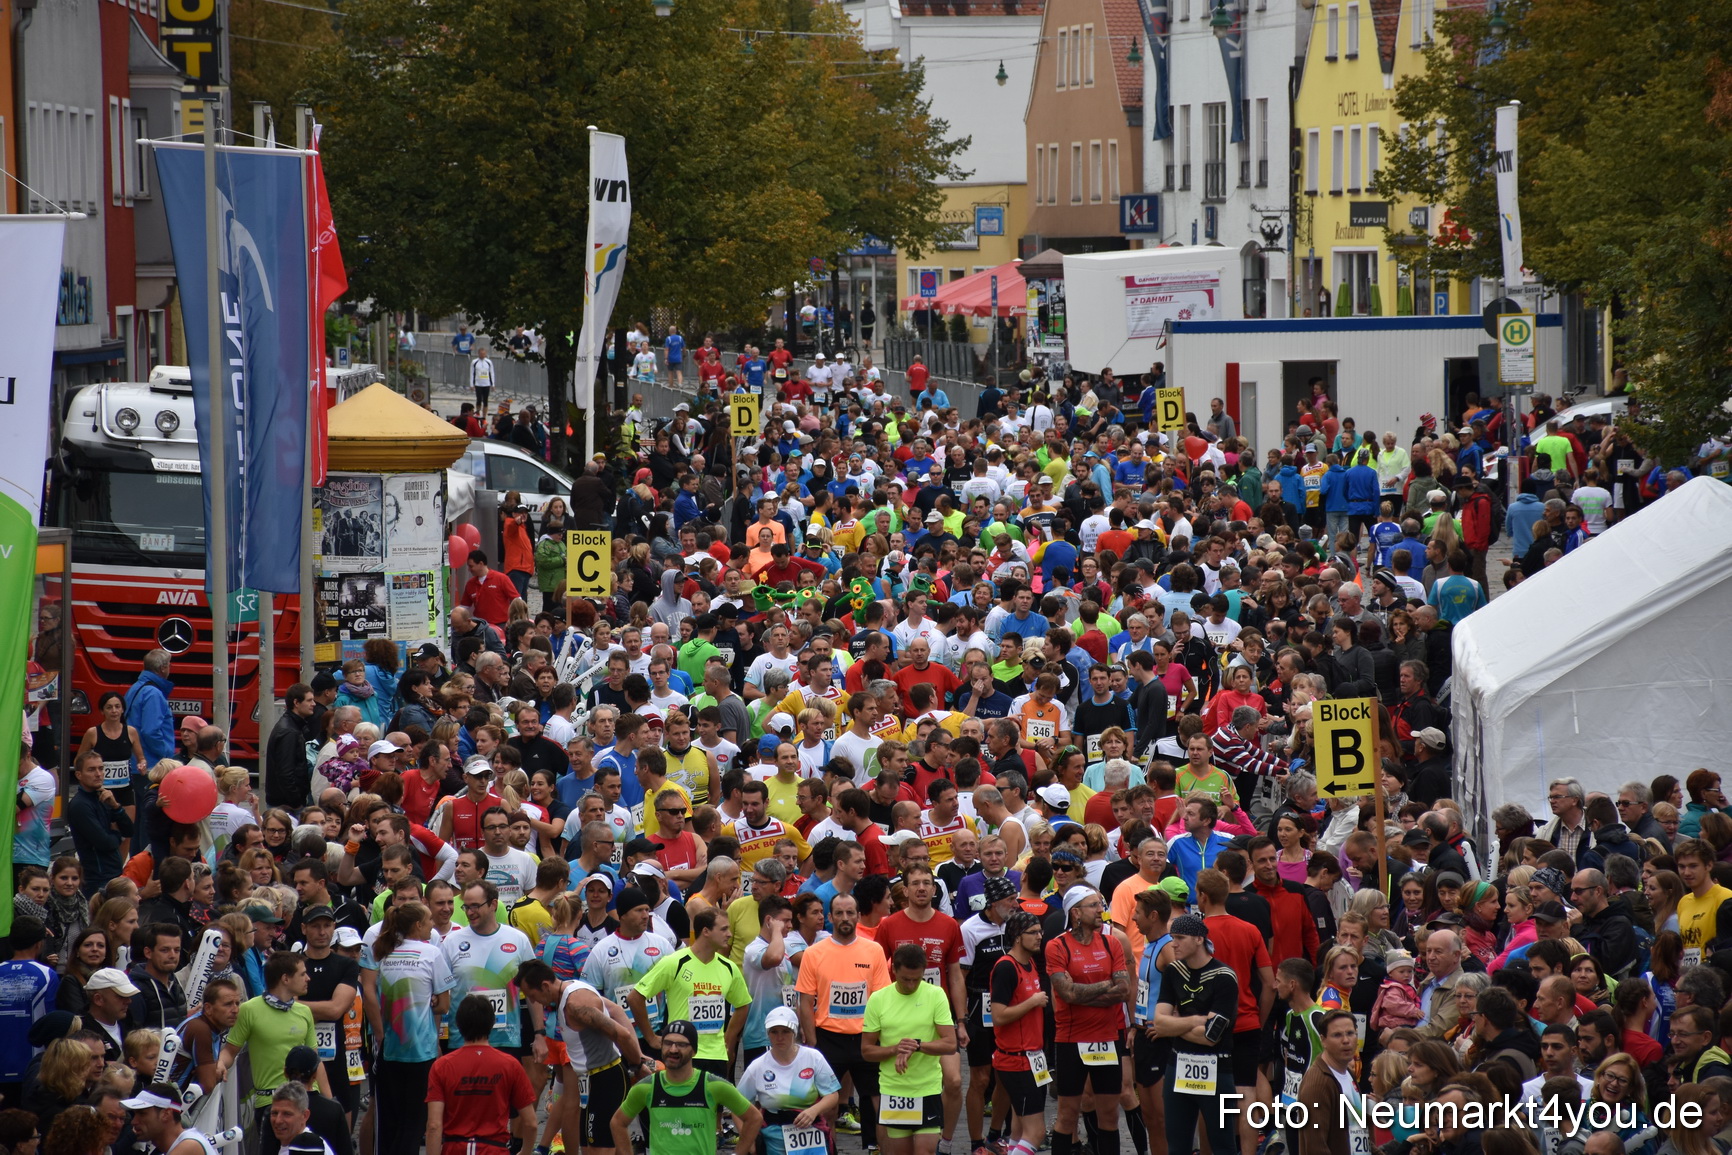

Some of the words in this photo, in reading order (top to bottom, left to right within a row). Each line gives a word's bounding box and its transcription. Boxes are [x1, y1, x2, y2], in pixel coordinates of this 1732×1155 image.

[1338, 92, 1360, 117] HOTEL
[1140, 295, 1174, 304] DAHMIT
[1509, 324, 1524, 340] H
[733, 395, 756, 404] Block
[1159, 389, 1182, 398] Block
[737, 406, 752, 427] D
[1164, 400, 1179, 422] D
[156, 474, 203, 487] böhseonk
[142, 538, 172, 547] BANFF
[572, 533, 606, 546] Block
[577, 550, 600, 582] C
[324, 581, 339, 591] MARK
[156, 589, 198, 606] AVIA
[320, 591, 339, 601] BENDER
[325, 606, 339, 616] BAND
[340, 608, 368, 617] CASH
[182, 702, 200, 712] 116
[1320, 703, 1371, 722] Block
[1032, 726, 1050, 738] 346
[1330, 728, 1366, 776] B
[104, 766, 128, 779] 2703
[740, 842, 760, 854] MAX
[763, 838, 785, 849] BÖG
[982, 946, 1003, 954] TEAM
[693, 981, 723, 992] Müller
[832, 990, 864, 1006] 2087
[693, 1004, 723, 1020] 2502
[1184, 1064, 1209, 1080] 209
[1184, 1081, 1207, 1090] Andreas
[888, 1095, 915, 1110] 538
[789, 1129, 823, 1149] 3070
[1354, 1136, 1371, 1153] 20
